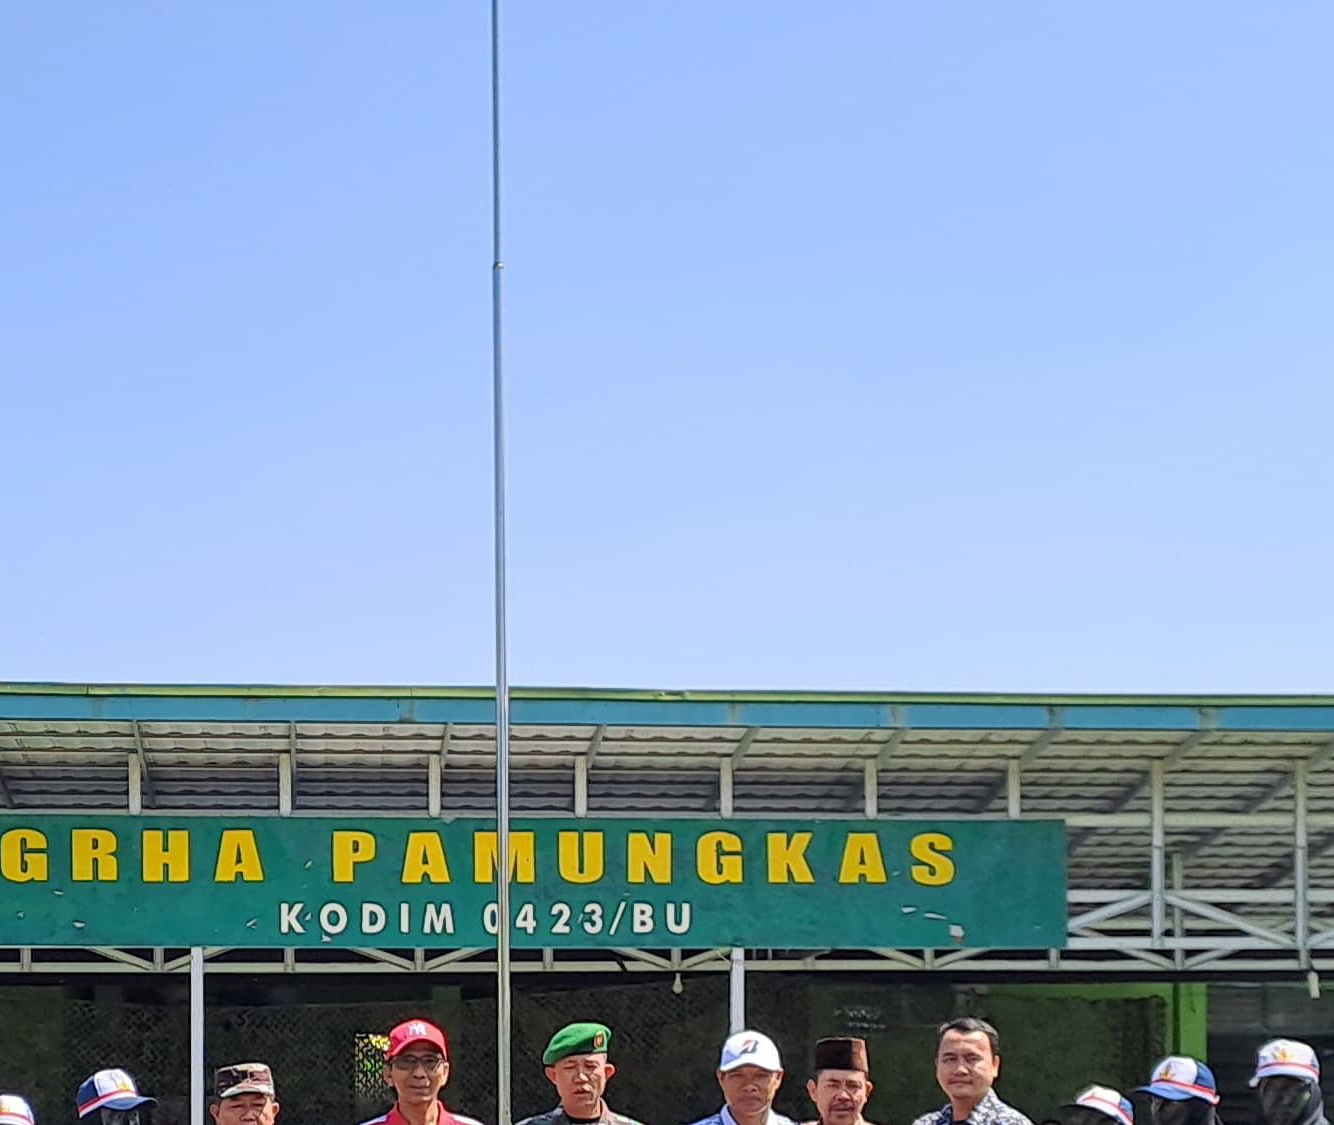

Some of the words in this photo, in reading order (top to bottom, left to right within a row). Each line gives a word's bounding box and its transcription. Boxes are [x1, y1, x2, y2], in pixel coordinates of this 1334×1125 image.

[0, 828, 265, 883] GRHA
[331, 830, 956, 886] PAMUNGKAS
[280, 902, 455, 935] KODIM
[482, 901, 692, 936] 0423/BU
